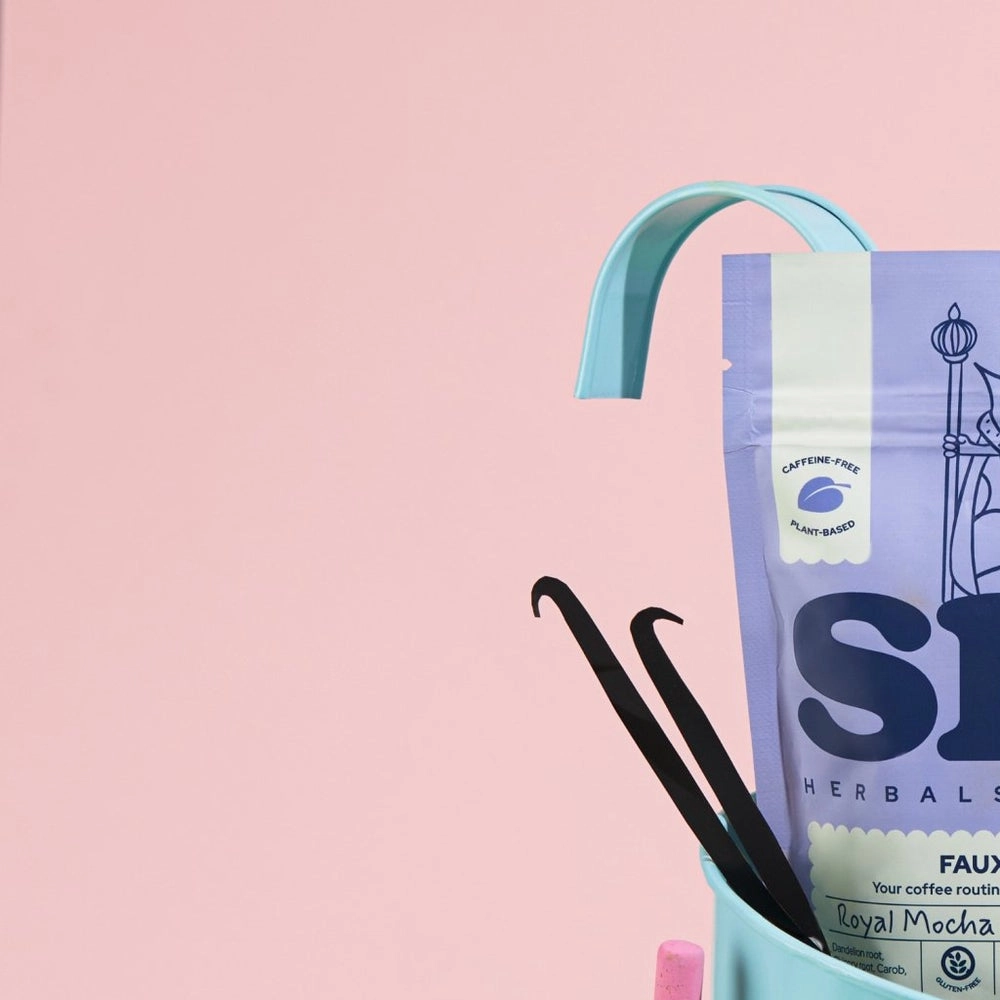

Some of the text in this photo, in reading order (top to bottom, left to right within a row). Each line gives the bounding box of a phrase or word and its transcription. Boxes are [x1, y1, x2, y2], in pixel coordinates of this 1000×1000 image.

[782, 456, 861, 475] CAFFEINE-FREE
[790, 519, 856, 537] PLANT-BASED
[872, 881, 902, 895] Your
[905, 883, 953, 896] coffee
[837, 903, 995, 939] Royal Mocha
[832, 942, 865, 957] Dandelion
[865, 951, 885, 962] root,
[876, 963, 908, 976] Carob,
[935, 976, 982, 993] GLUTEN-FREE
